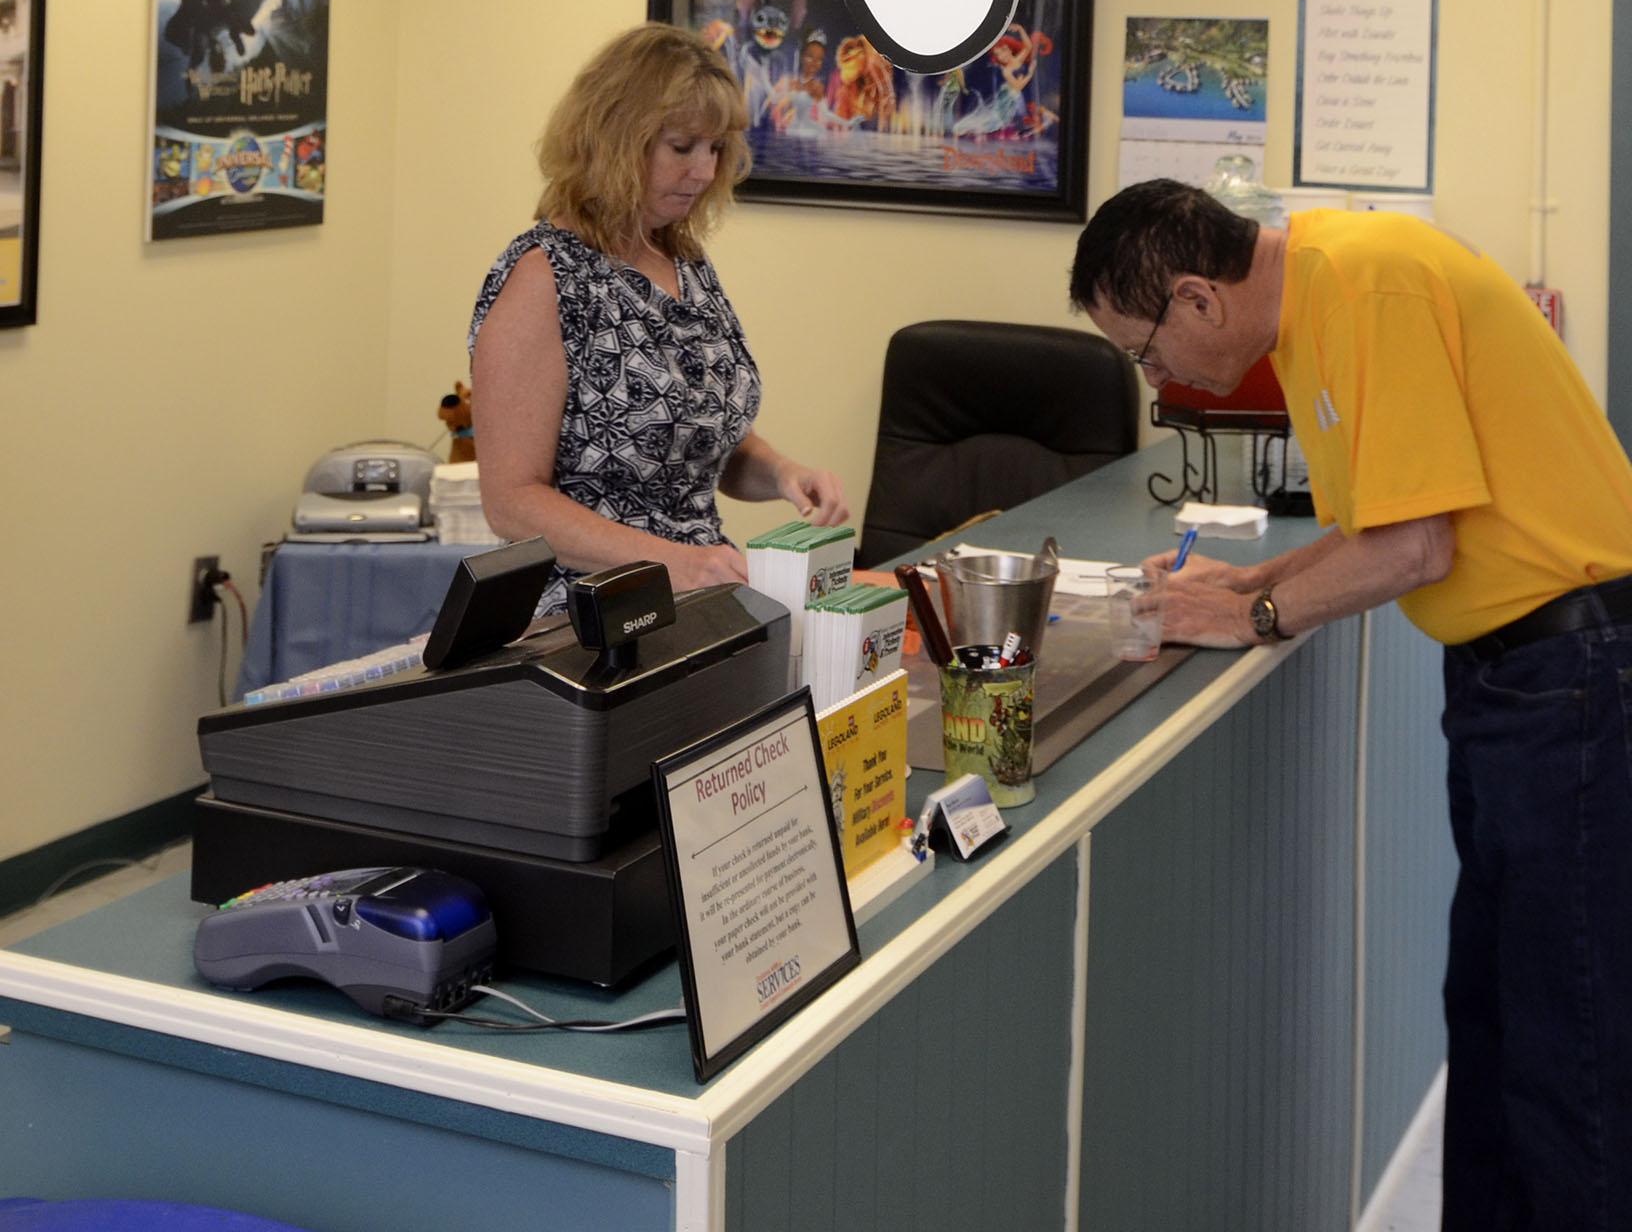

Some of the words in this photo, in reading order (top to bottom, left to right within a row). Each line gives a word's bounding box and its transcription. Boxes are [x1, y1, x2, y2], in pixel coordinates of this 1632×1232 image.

[623, 612, 657, 633] SHARP
[828, 725, 858, 751] LEGOLAND
[874, 700, 902, 723] LEGOLAND
[695, 750, 752, 803] Returned
[754, 732, 790, 769] Check
[731, 780, 766, 817] Policy
[730, 849, 746, 866] check
[743, 912, 758, 929] check
[757, 955, 800, 1003] SERVICES
